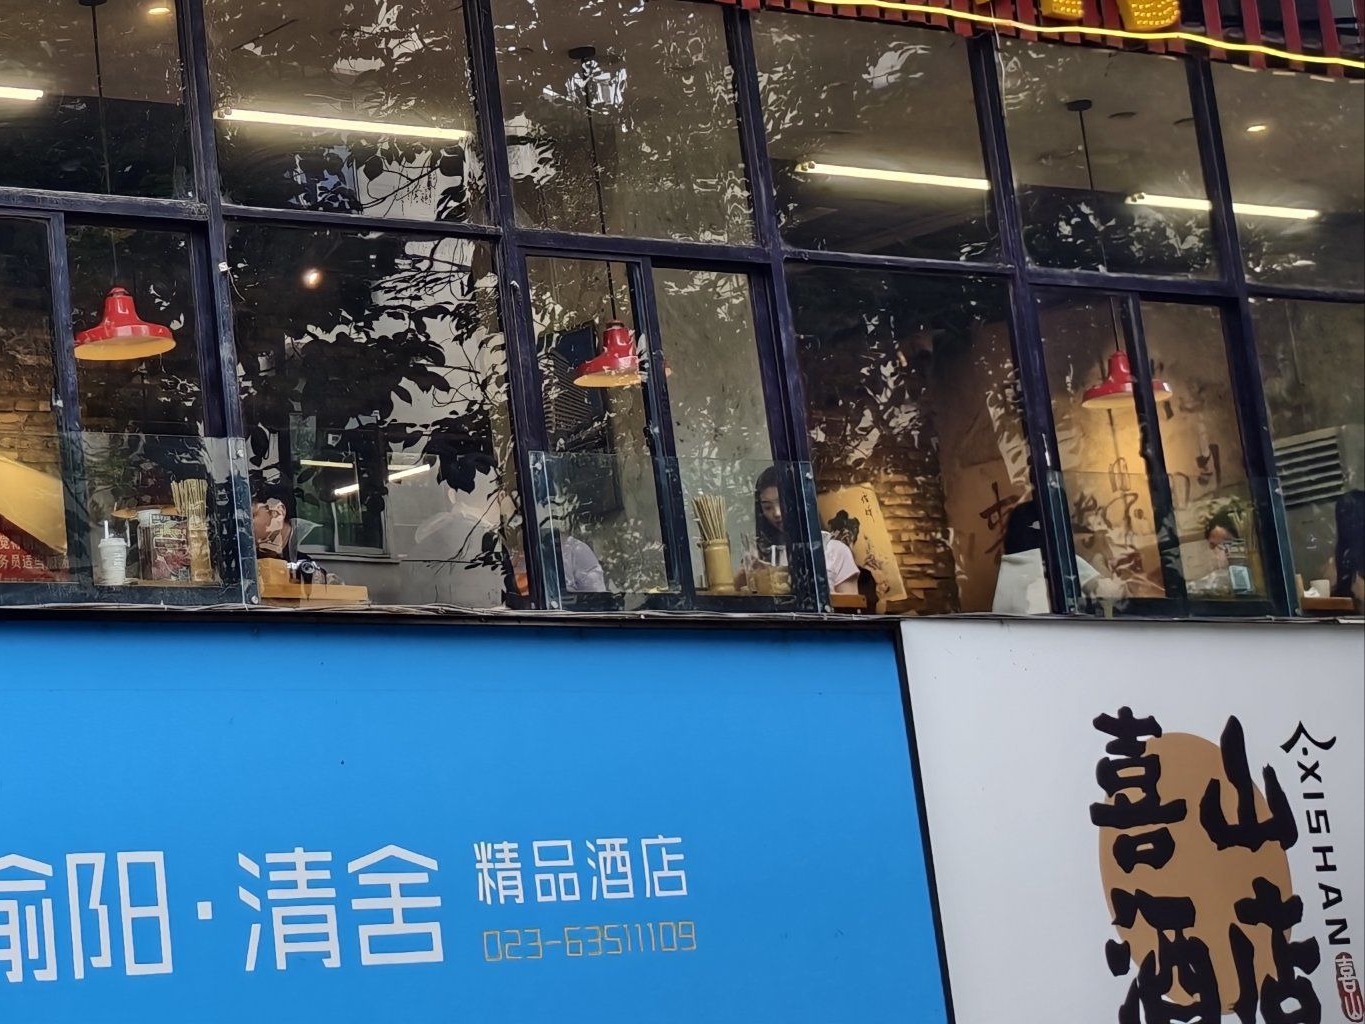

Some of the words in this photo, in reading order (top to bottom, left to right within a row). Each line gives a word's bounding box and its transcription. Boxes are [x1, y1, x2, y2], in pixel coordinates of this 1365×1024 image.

[474, 834, 688, 905] 精品酒店
[1296, 760, 1351, 946] XISHAN
[483, 920, 697, 963] 023-63511109
